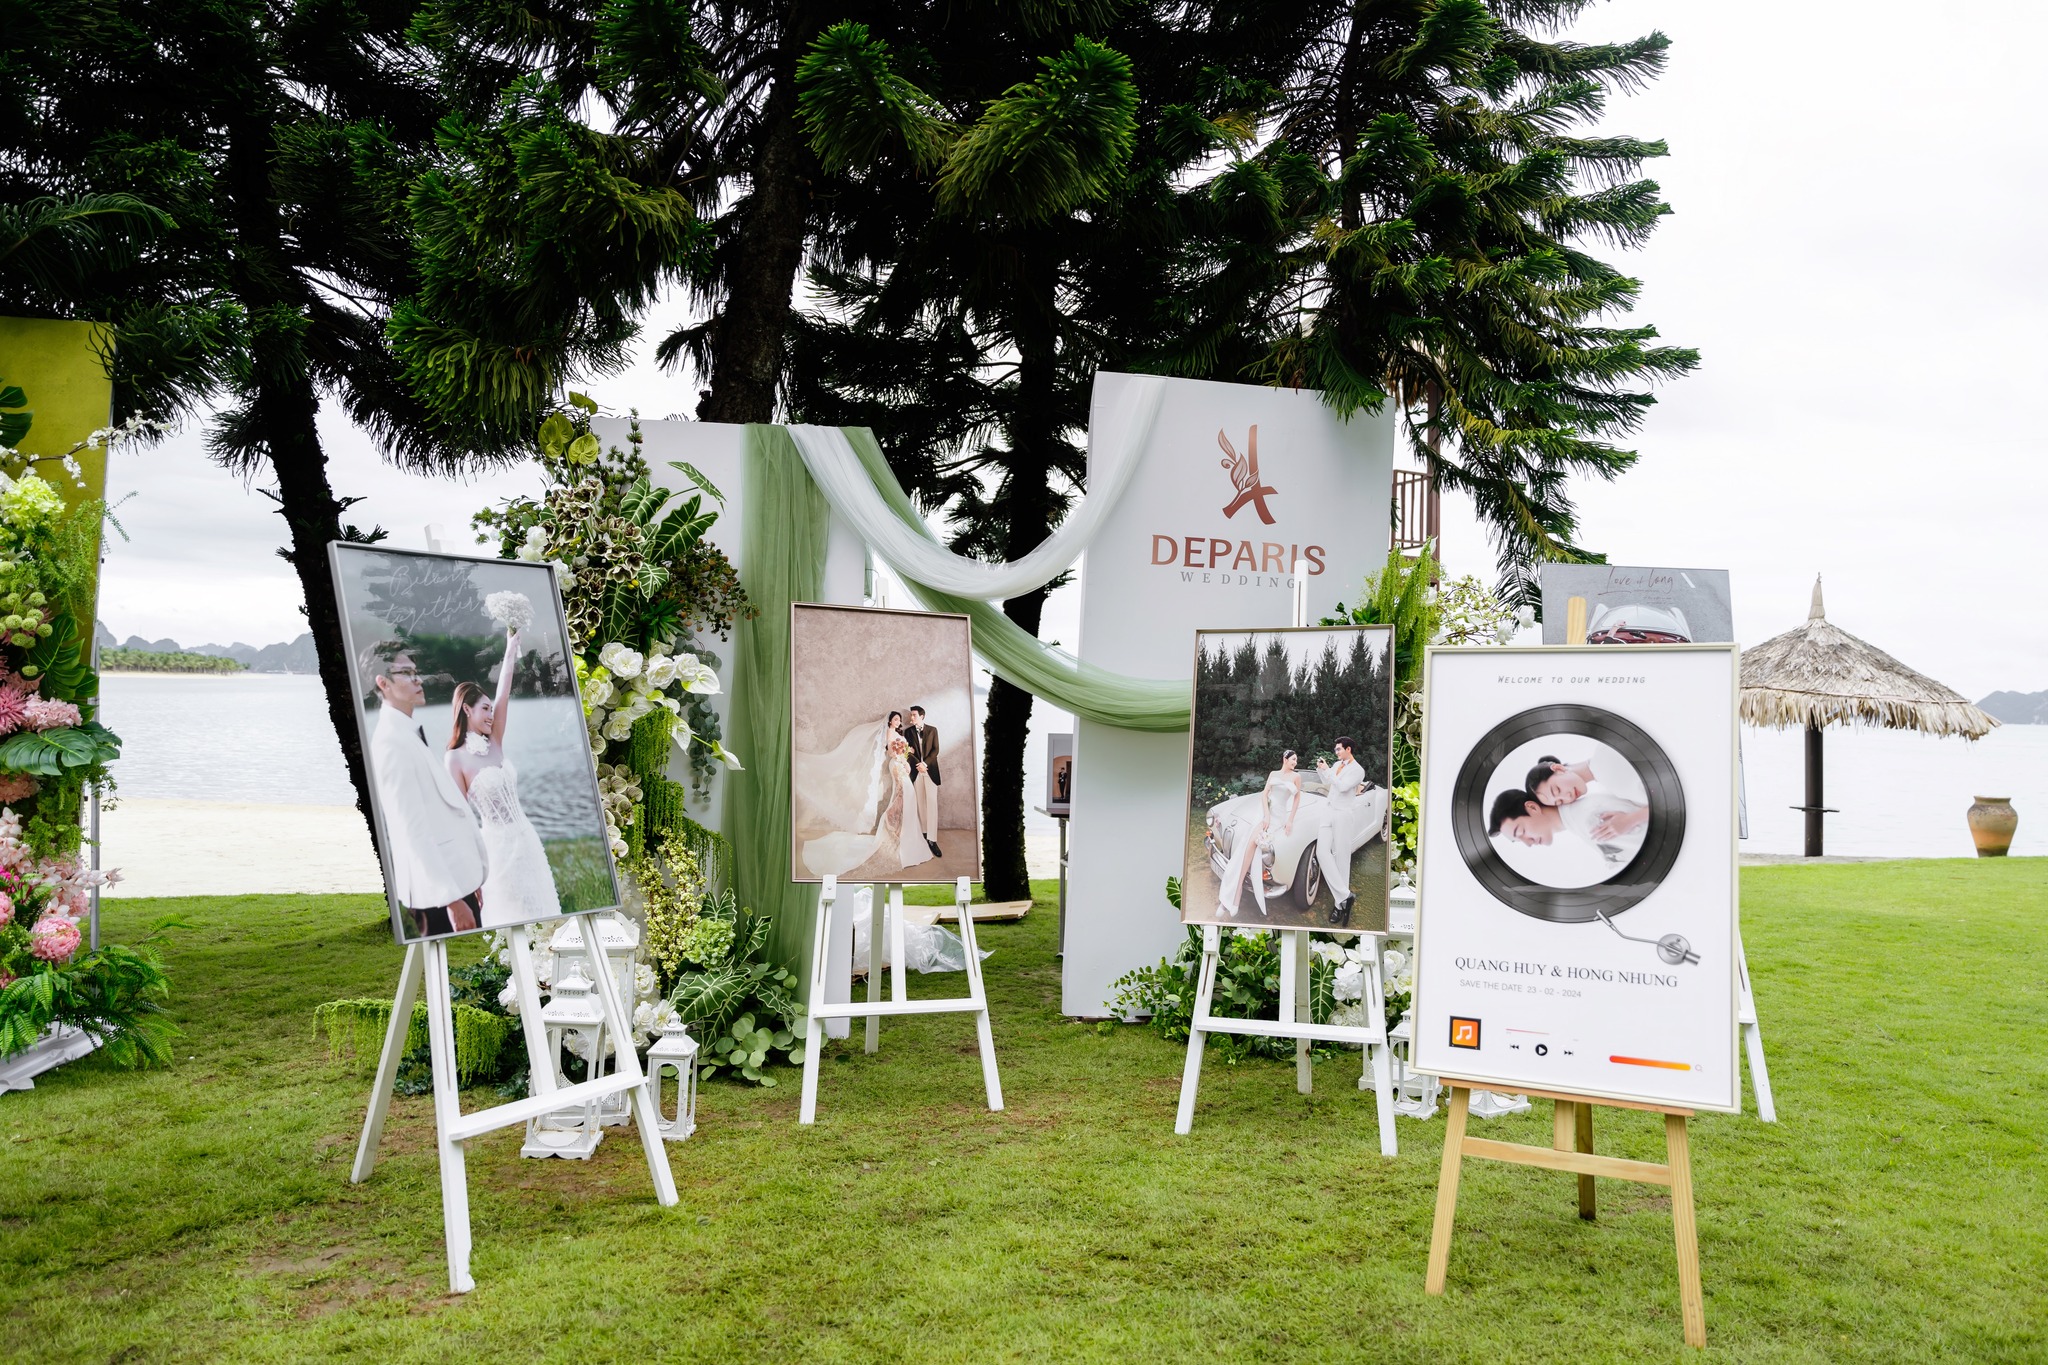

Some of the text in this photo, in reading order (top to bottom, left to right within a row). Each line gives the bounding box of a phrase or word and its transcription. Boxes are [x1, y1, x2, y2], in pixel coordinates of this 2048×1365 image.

[1150, 534, 1326, 576] DEPARIS
[1180, 571, 1295, 589] WEDDING
[1598, 676, 1646, 684] WEDDING
[1455, 956, 1678, 988] QUANG HUY & HONG NHUNG
[1459, 978, 1481, 989] SAVE
[1483, 981, 1499, 990] THE
[1501, 982, 1522, 993] DATE
[1527, 985, 1537, 994] 23
[1544, 987, 1554, 996] 02
[1562, 988, 1582, 998] 2024
